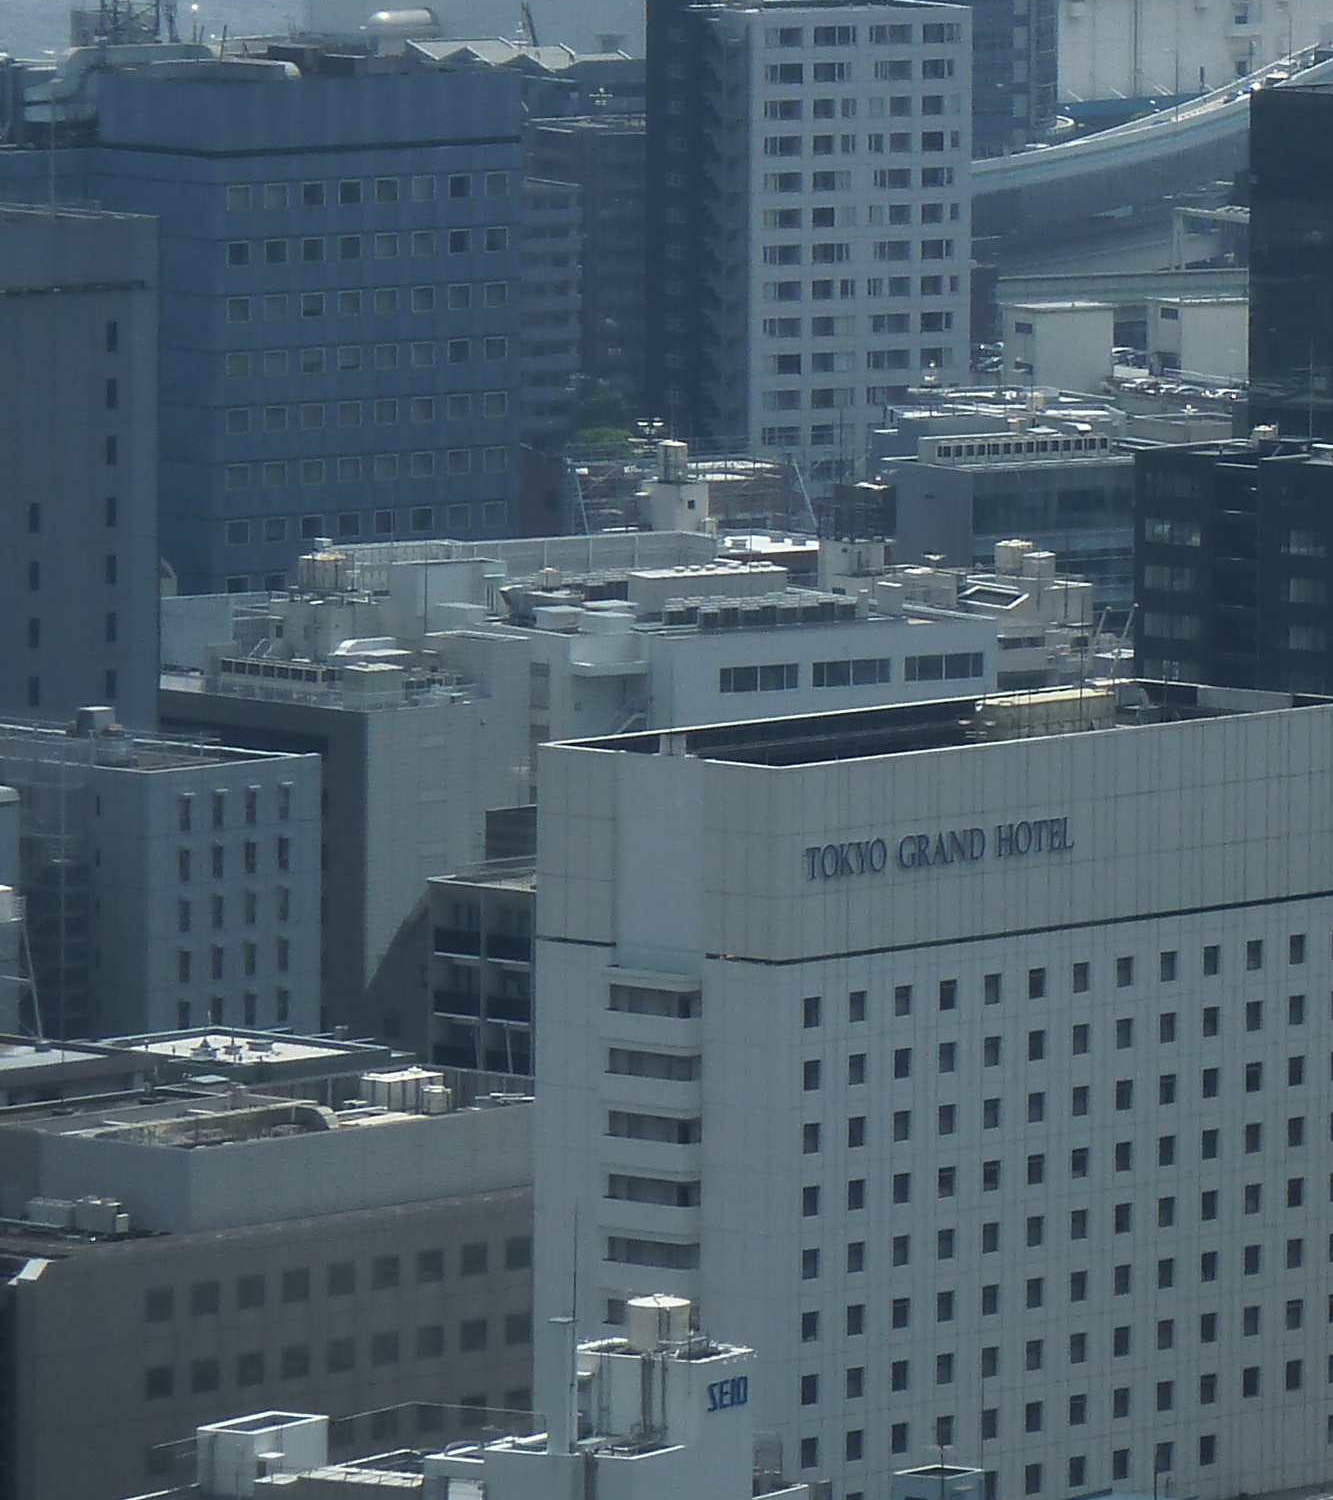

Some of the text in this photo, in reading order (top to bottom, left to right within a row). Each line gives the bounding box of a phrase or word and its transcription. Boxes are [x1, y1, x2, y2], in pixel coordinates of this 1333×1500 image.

[805, 817, 1075, 880] TOKYO GRAND HOTEL
